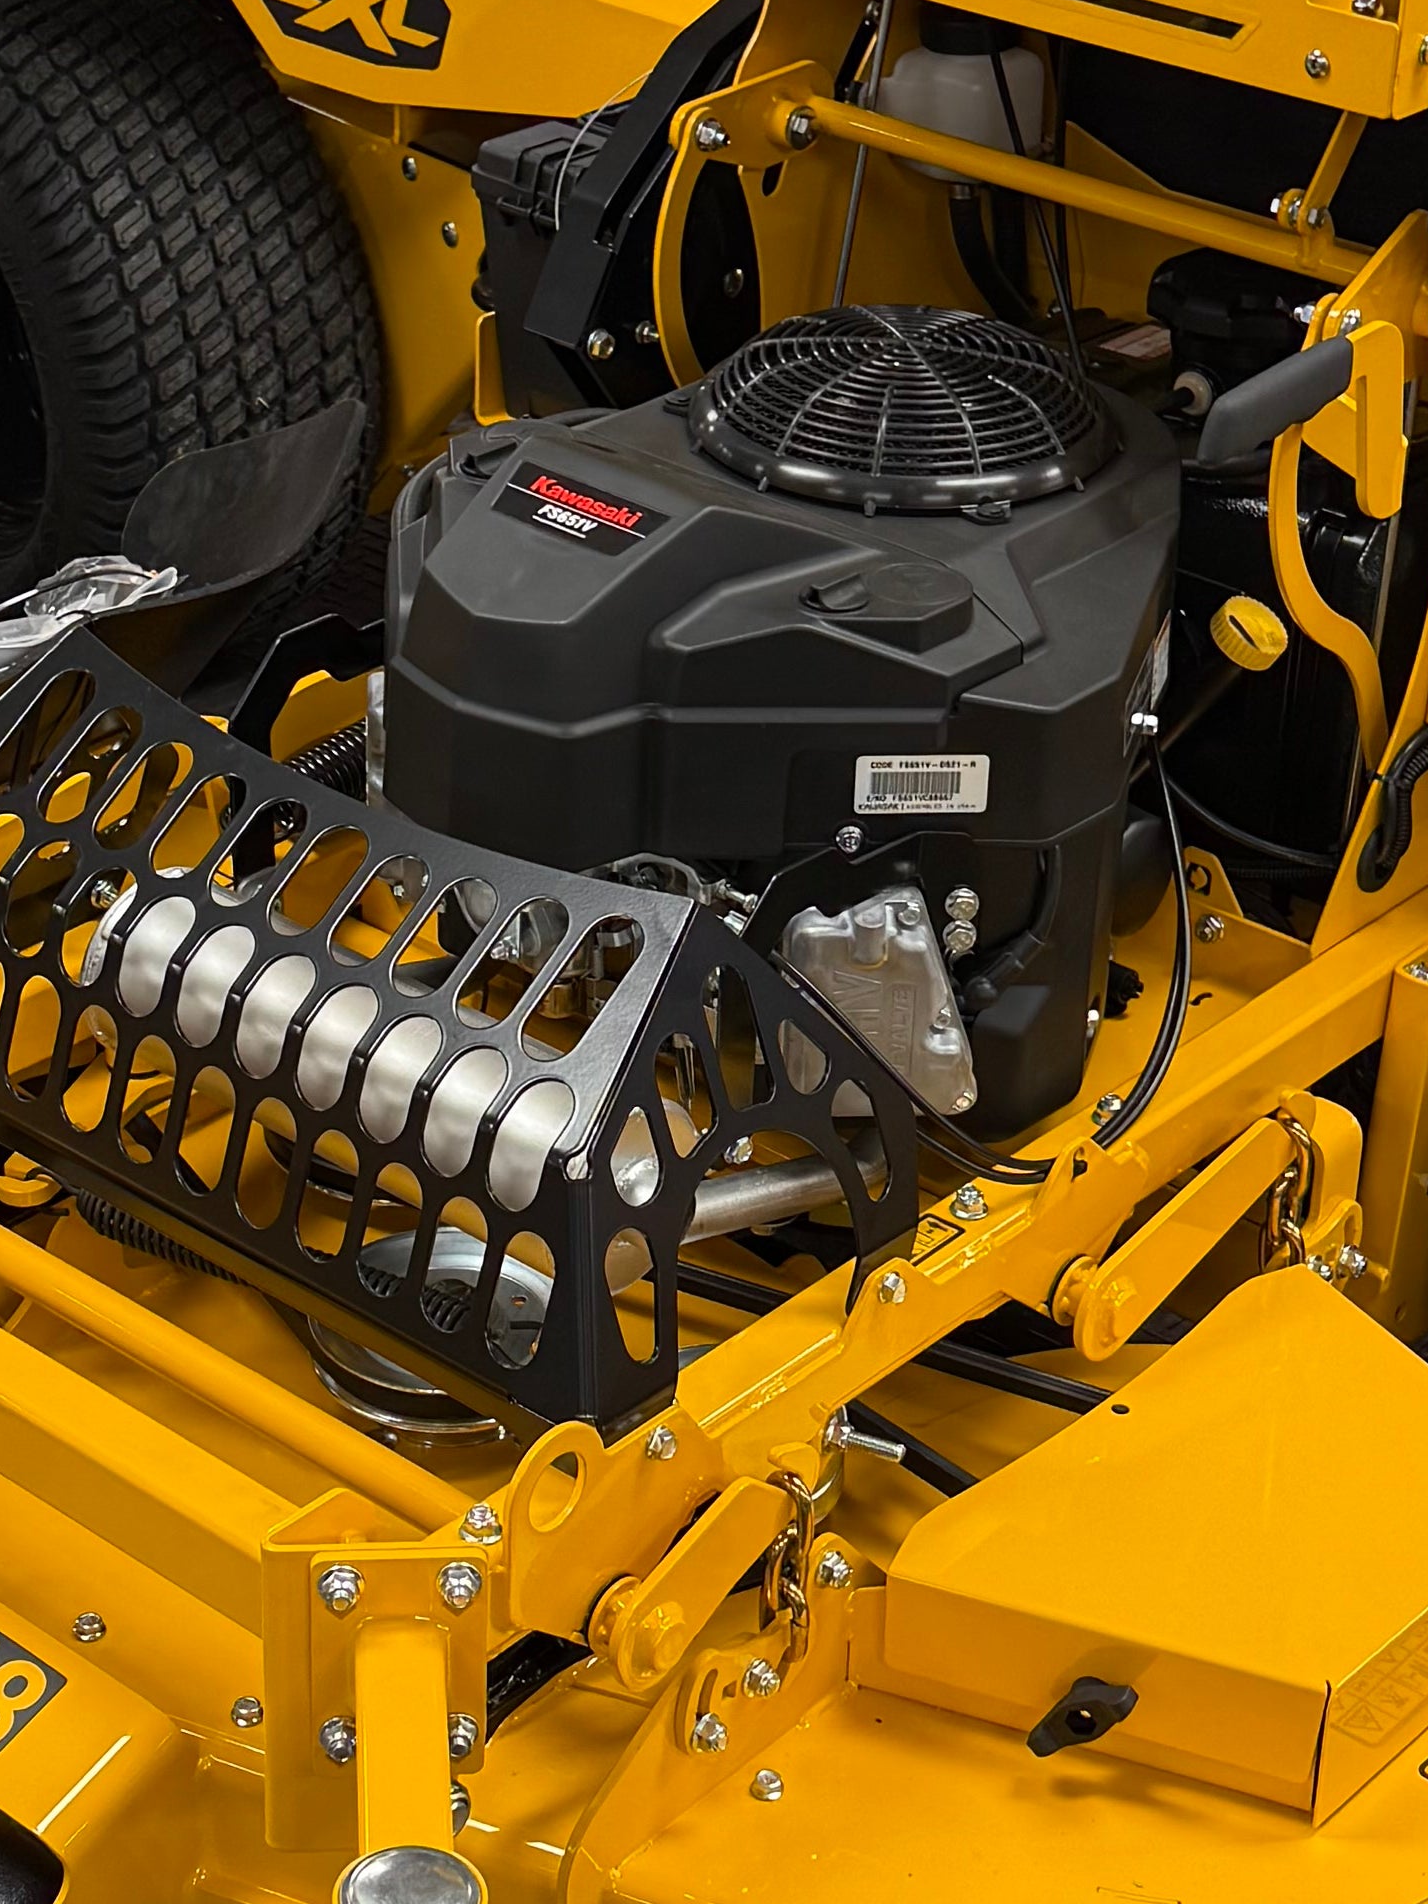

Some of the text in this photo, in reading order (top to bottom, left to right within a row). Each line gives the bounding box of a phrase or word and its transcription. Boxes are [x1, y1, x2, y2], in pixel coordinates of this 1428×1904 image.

[529, 475, 643, 528] Kawasaki
[537, 504, 599, 533] FS651V
[870, 761, 893, 769] CODE
